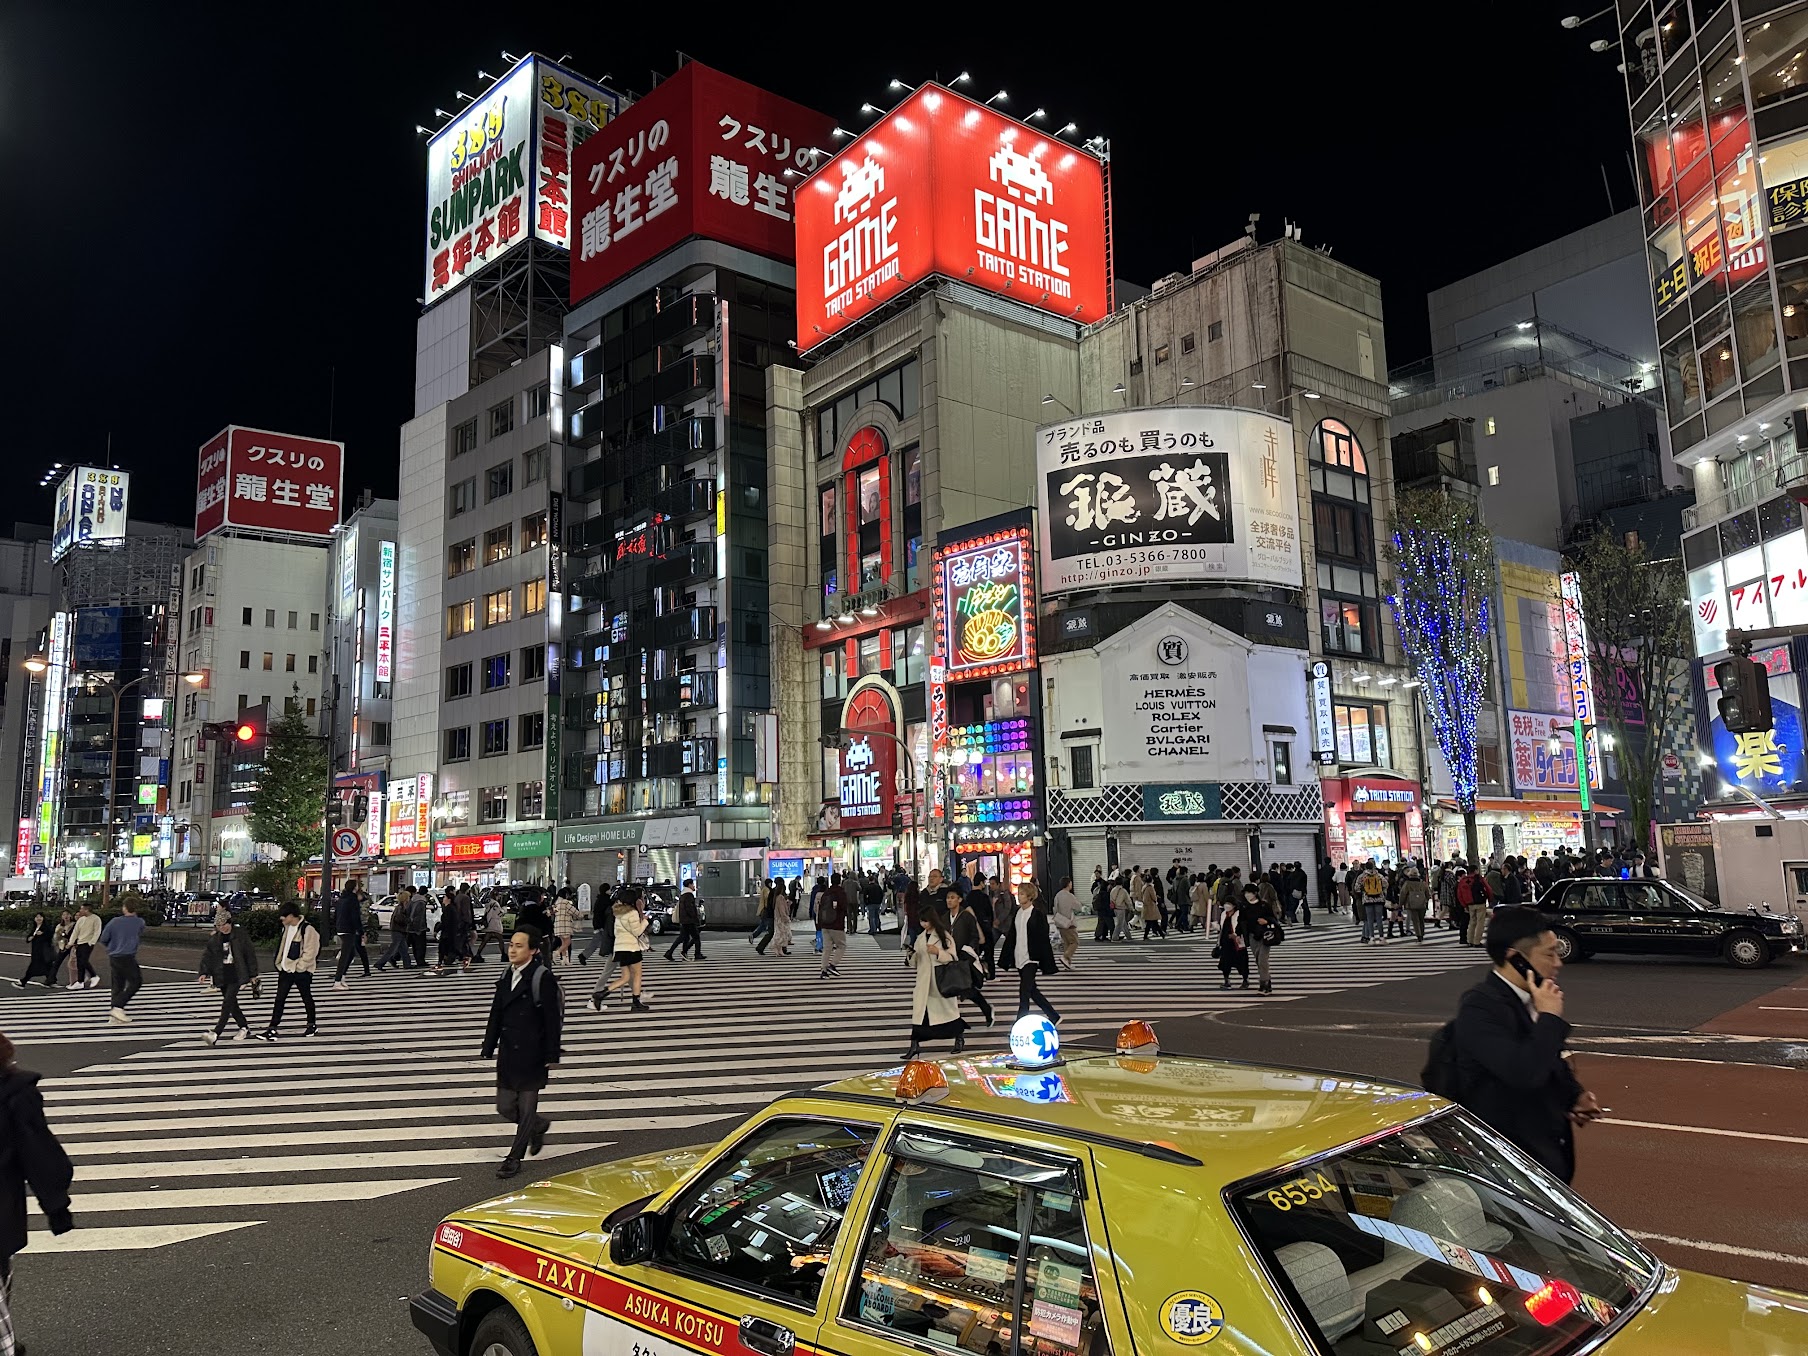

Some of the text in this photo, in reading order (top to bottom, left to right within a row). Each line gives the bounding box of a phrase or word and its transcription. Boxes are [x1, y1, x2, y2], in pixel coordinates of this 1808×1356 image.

[541, 75, 609, 130] 389
[451, 95, 508, 174] 389
[718, 114, 819, 173] クスリの
[452, 138, 503, 192] SHINJUKU
[588, 119, 669, 196] クスリの
[430, 140, 526, 250] SUNPARK
[709, 155, 797, 224] 龍生
[580, 156, 679, 262] 龍生堂
[1772, 201, 1808, 223] 診
[975, 188, 1070, 277] GAME
[823, 196, 899, 298] GAME
[1692, 235, 1722, 279] 祝日
[977, 249, 1071, 298] TAITO STATION
[825, 257, 899, 318] TAITO STATION
[1044, 420, 1105, 445] ブランド品
[247, 445, 325, 471] クスリの
[1060, 430, 1215, 464] 売るのも買うのも
[200, 447, 226, 477] クスリの
[86, 472, 120, 485] 389
[234, 473, 335, 511] 龍生堂
[1059, 458, 1220, 532] 銀蔵
[1250, 520, 1294, 540] 全球奢侈品
[1256, 536, 1291, 553] 交流平台
[1076, 548, 1207, 571] TEL.03-5366-7800
[1208, 563, 1224, 571] 検索
[381, 546, 394, 620] 新宿サンパーク
[1061, 565, 1151, 584] http://ginzo.jp
[1732, 569, 1808, 611] アイフル
[378, 627, 391, 677] 三平本館
[1163, 640, 1183, 661] 質
[551, 656, 559, 681] Vitule
[1129, 671, 1218, 682] 高価買取 激安販売
[1315, 664, 1326, 677] 質
[1144, 685, 1206, 698] HERMÈS
[1573, 657, 1588, 719] ダイコク
[931, 685, 946, 741] ラーメン
[1135, 700, 1216, 711] LOUIS VUITTON
[1152, 712, 1201, 721] ROLEX
[1150, 723, 1204, 733] Cartier
[1513, 715, 1534, 736] 免税
[1535, 719, 1544, 727] Tax
[1535, 728, 1546, 736] Free
[1146, 734, 1210, 745] BVLGARI
[1148, 746, 1210, 756] CHANEL
[1514, 743, 1534, 783] 薬
[1536, 744, 1577, 785] ダイコク
[1734, 731, 1783, 780] 楽
[840, 771, 881, 806] GAME
[1368, 789, 1414, 802] TAITO STATION
[370, 797, 379, 840] 三平ストア
[841, 804, 881, 817] TAITO STATION
[564, 829, 636, 844] Life Design! HOME LAB
[1328, 827, 1344, 838] GAME
[32, 845, 42, 855] P
[682, 867, 688, 877] P
[1043, 1030, 1059, 1051] N
[1267, 1172, 1338, 1212] 6554
[536, 1257, 586, 1296] TAXI
[863, 1298, 893, 1314] ABOARD!
[864, 1290, 894, 1305] WELCOME
[1168, 1293, 1216, 1309] EXCELLENT SERVICE TAXI
[624, 1293, 724, 1346] ASUKA KOTSU
[1034, 1307, 1079, 1327] 防犯カメラ作動中
[1169, 1303, 1213, 1334] 優良
